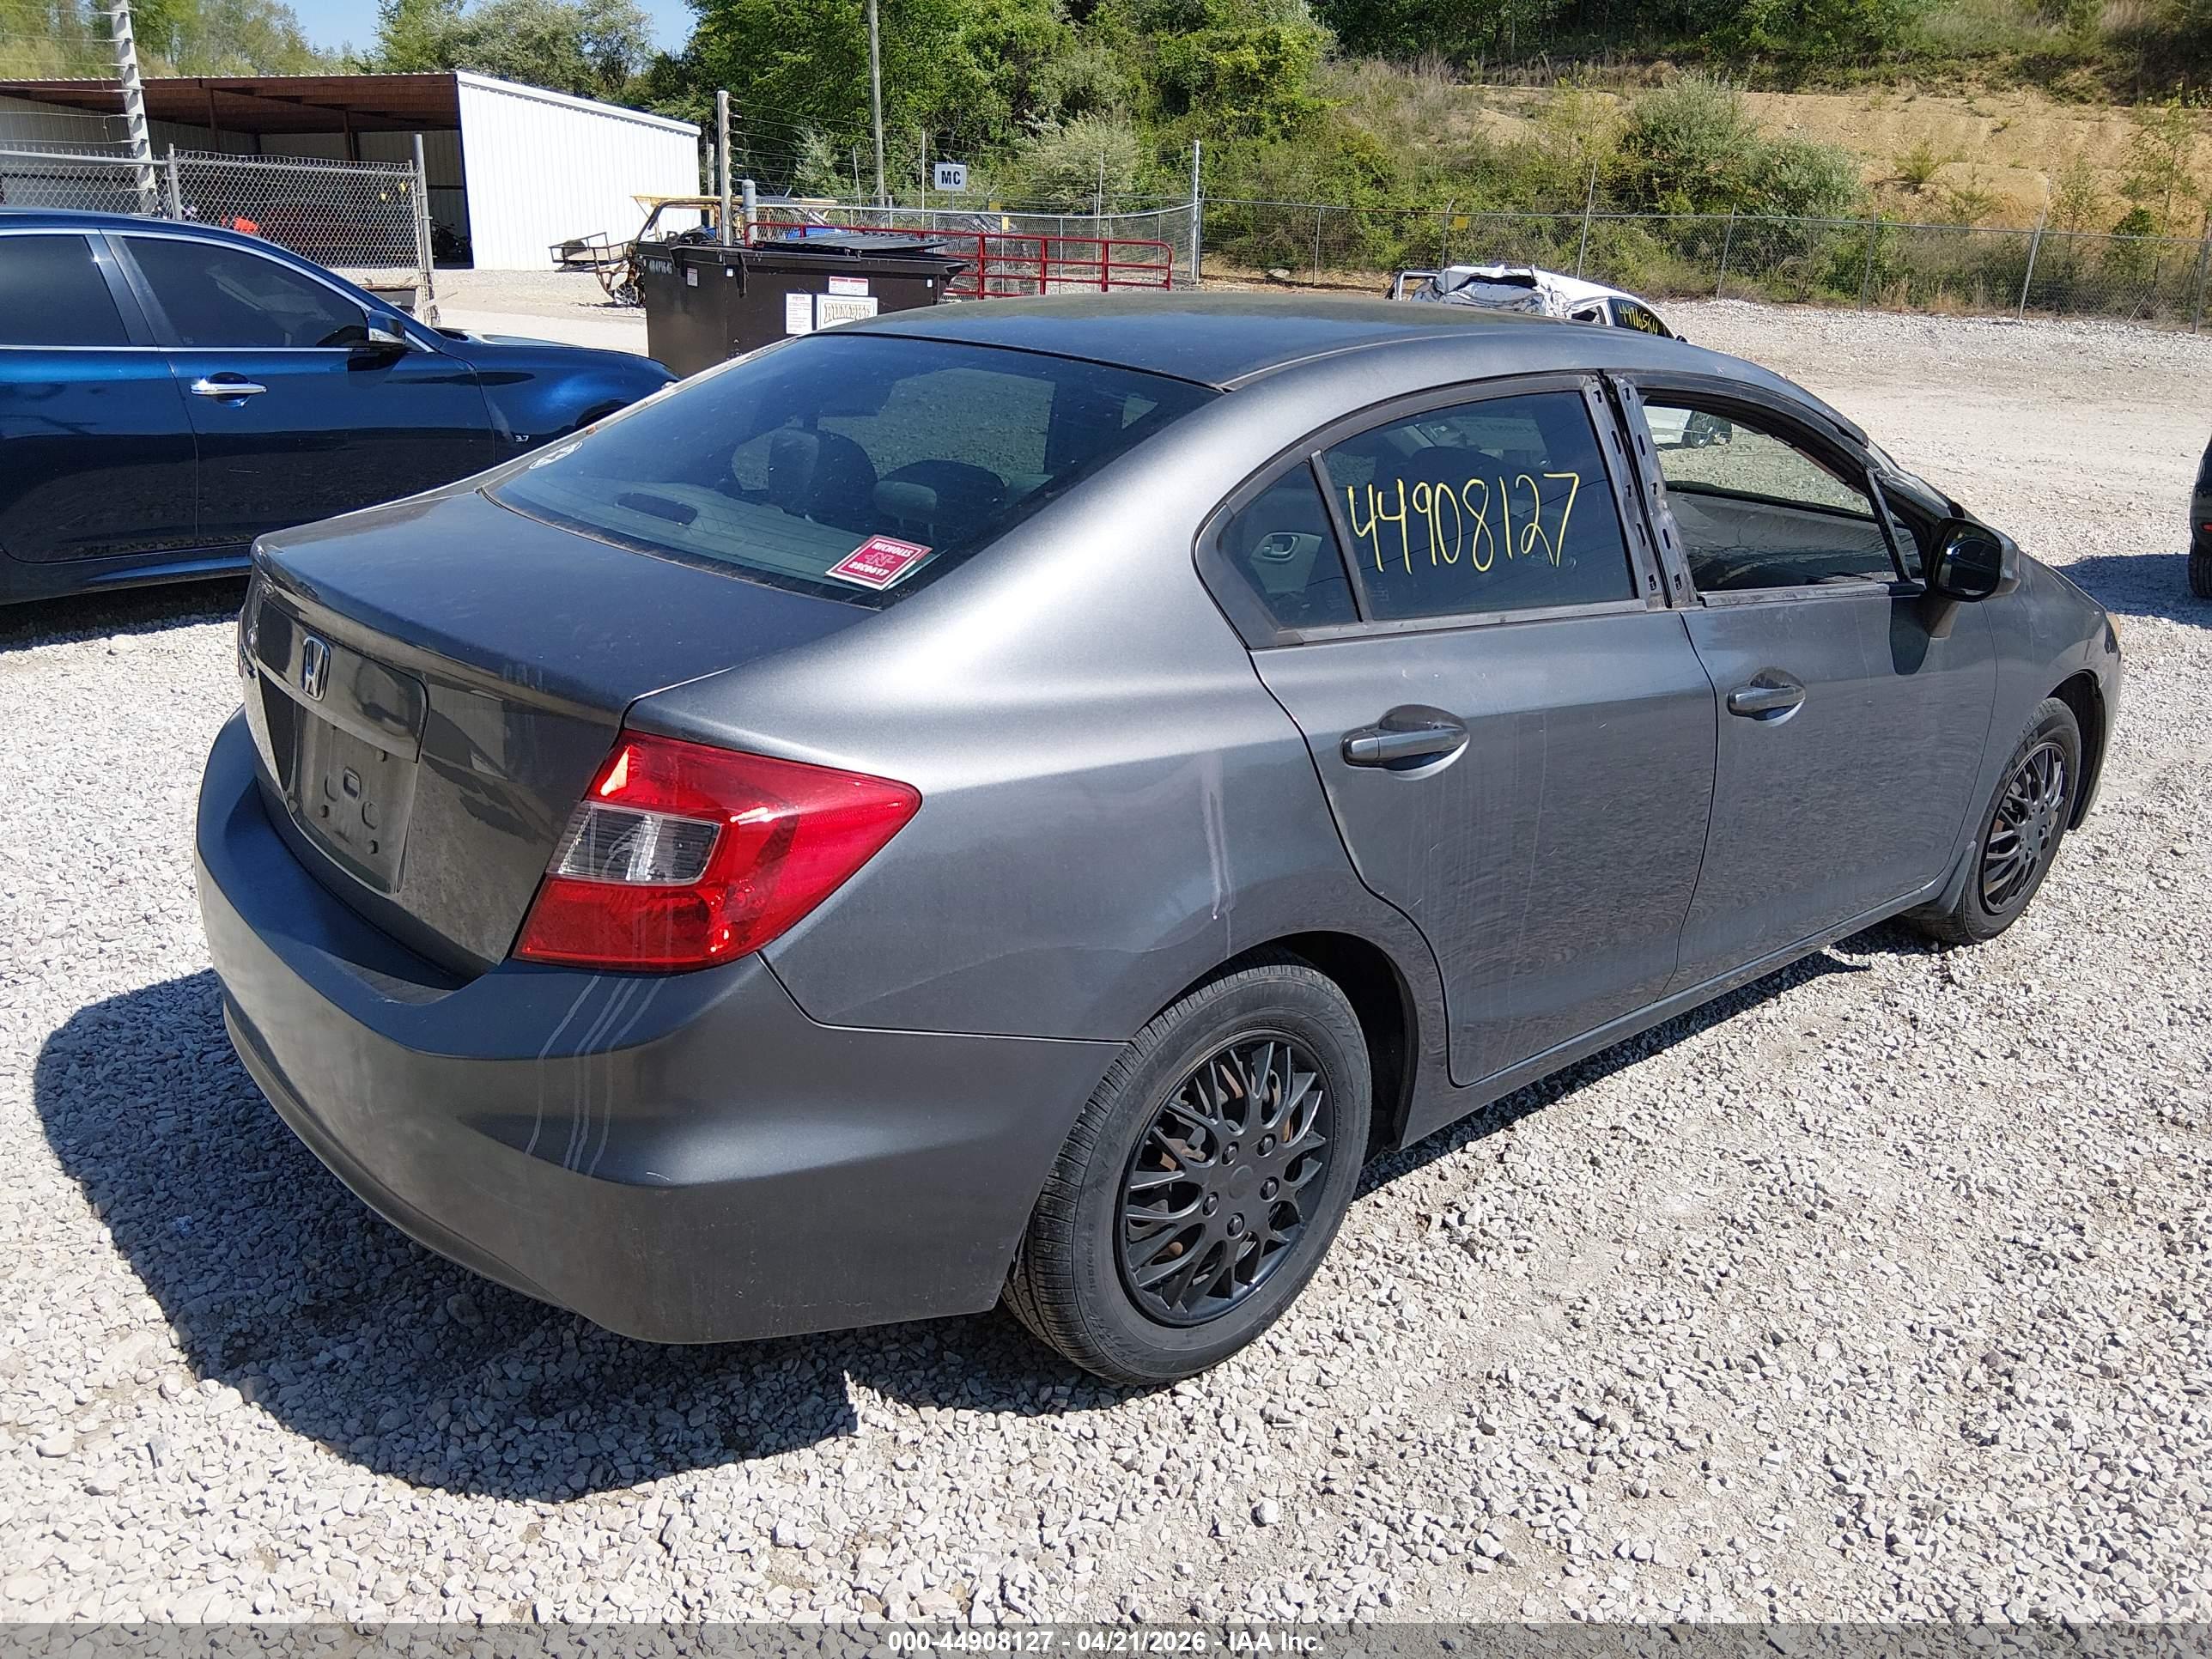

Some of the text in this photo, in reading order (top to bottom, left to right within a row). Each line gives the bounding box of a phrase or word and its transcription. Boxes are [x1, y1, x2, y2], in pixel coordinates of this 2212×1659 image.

[941, 170, 961, 185] MC
[824, 302, 872, 324] RUMPKE
[1347, 472, 1580, 574] 44908127
[871, 542, 915, 557] NICHOLLS
